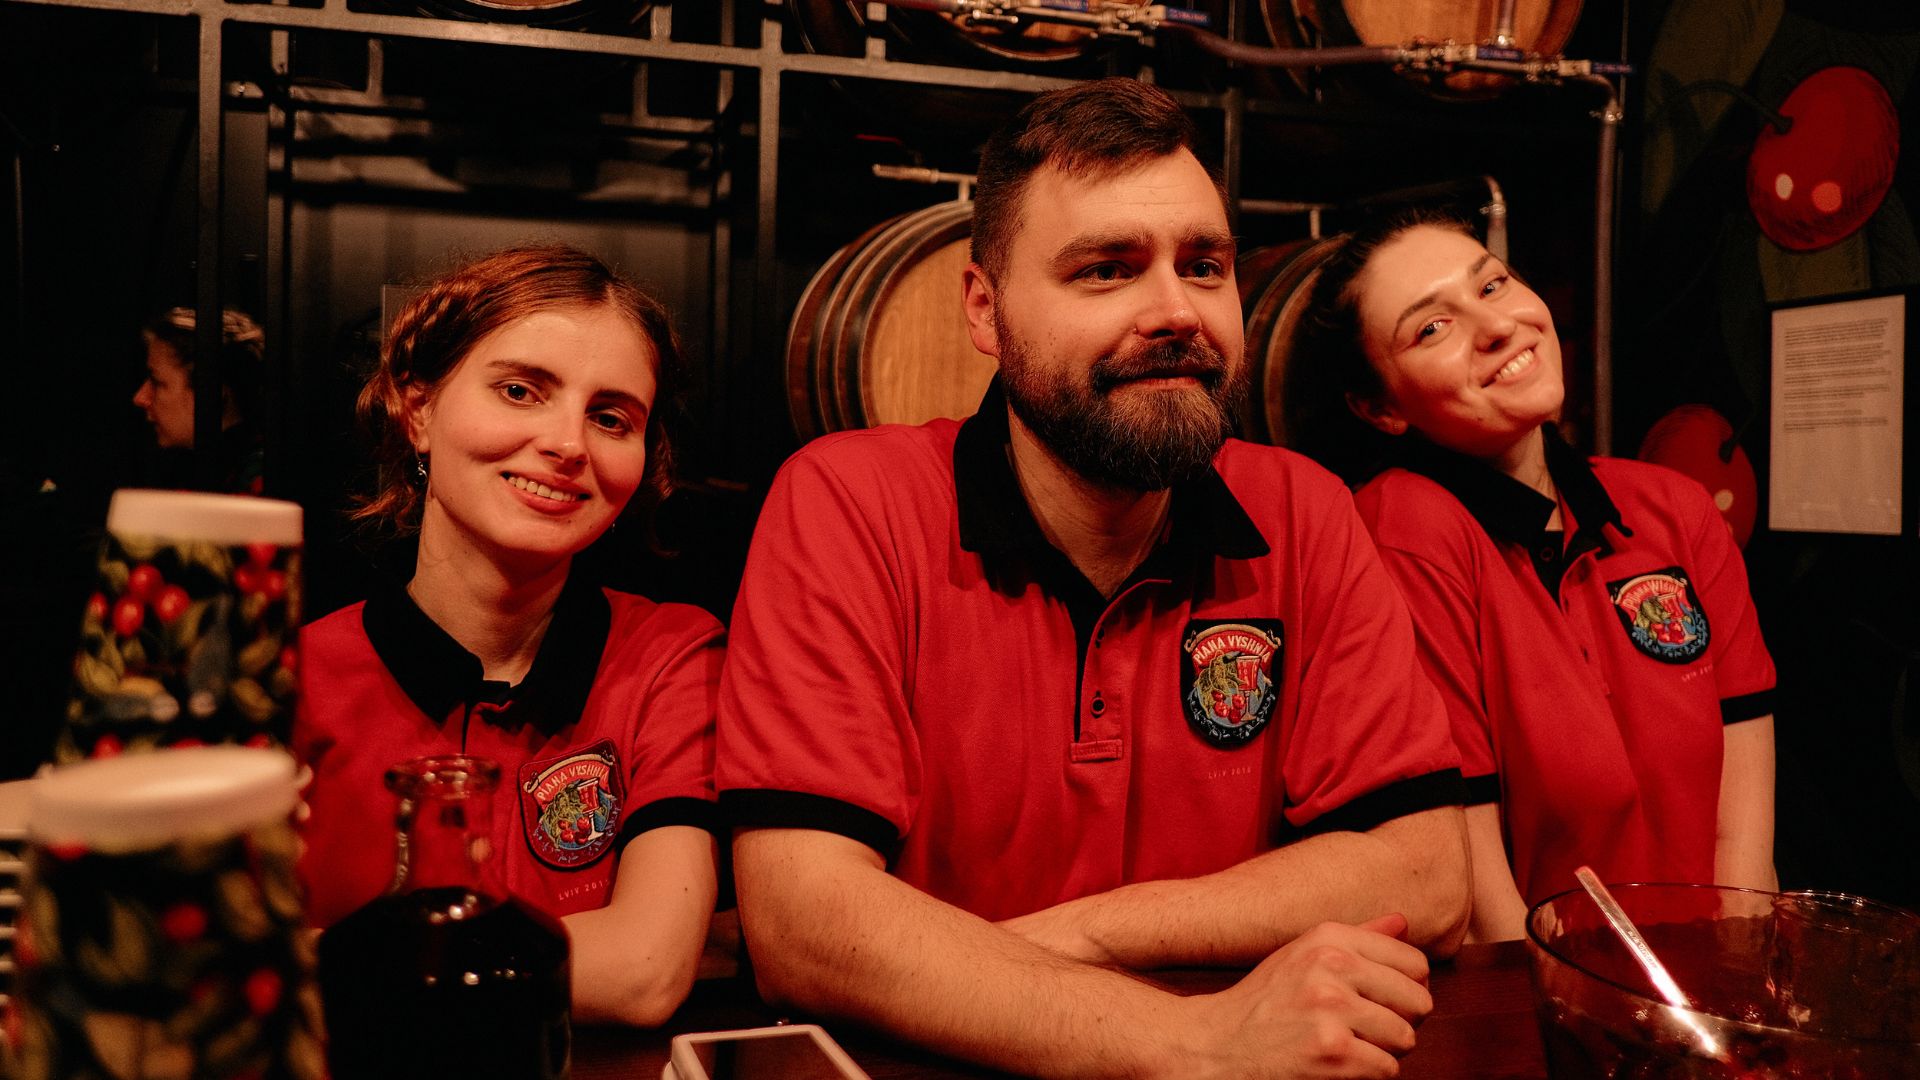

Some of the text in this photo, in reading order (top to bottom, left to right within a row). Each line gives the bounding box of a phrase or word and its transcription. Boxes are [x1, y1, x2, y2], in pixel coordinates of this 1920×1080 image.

[1227, 634, 1271, 663] VYSHNIA
[568, 764, 610, 784] VYSHNIA
[558, 887, 580, 901] LVIV
